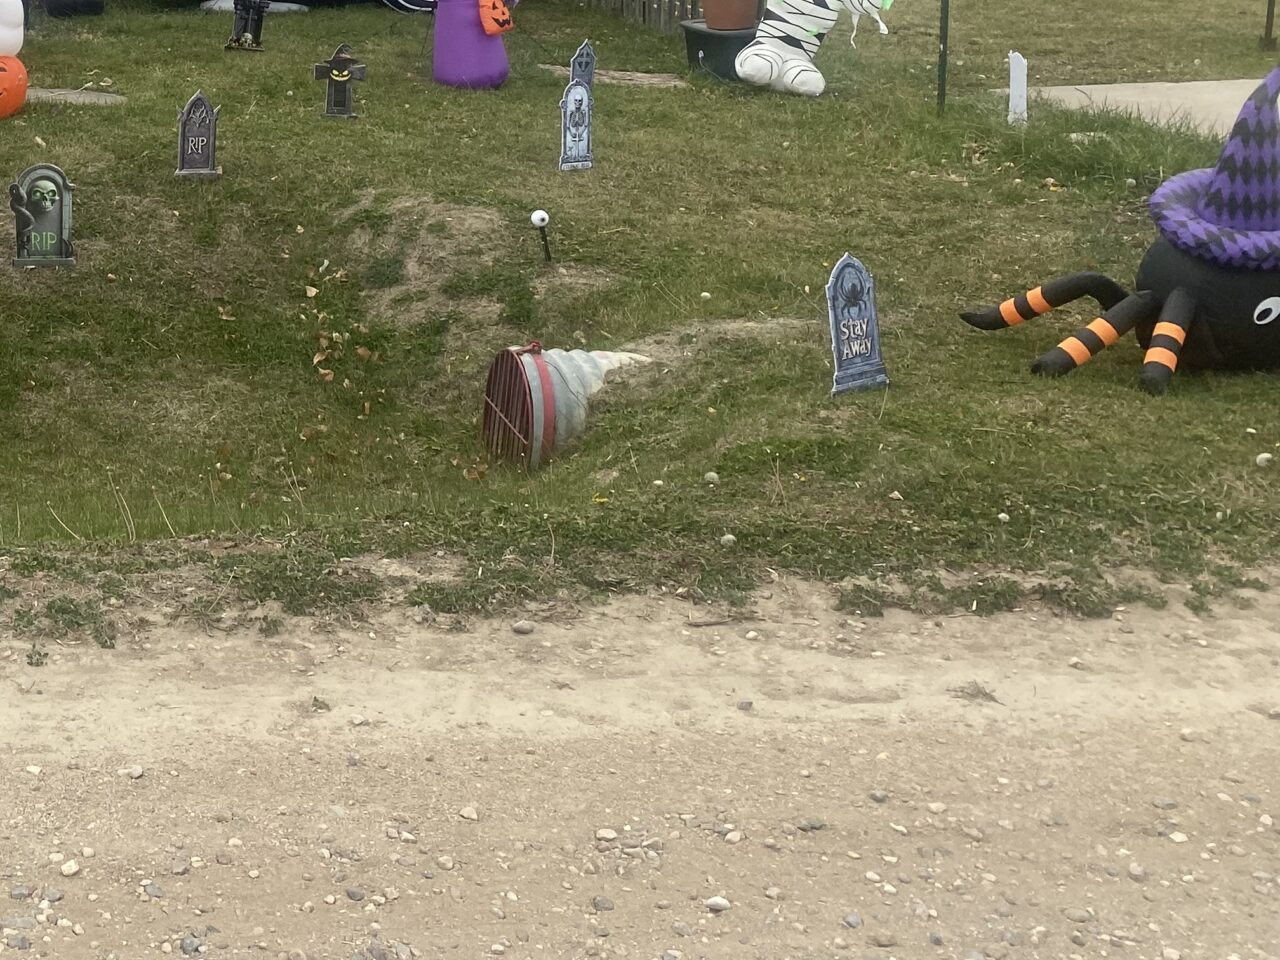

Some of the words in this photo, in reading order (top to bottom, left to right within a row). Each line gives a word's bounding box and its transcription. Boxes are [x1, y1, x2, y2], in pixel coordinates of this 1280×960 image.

[187, 136, 207, 155] RIP
[31, 231, 58, 251] RIP
[840, 318, 869, 341] Stay
